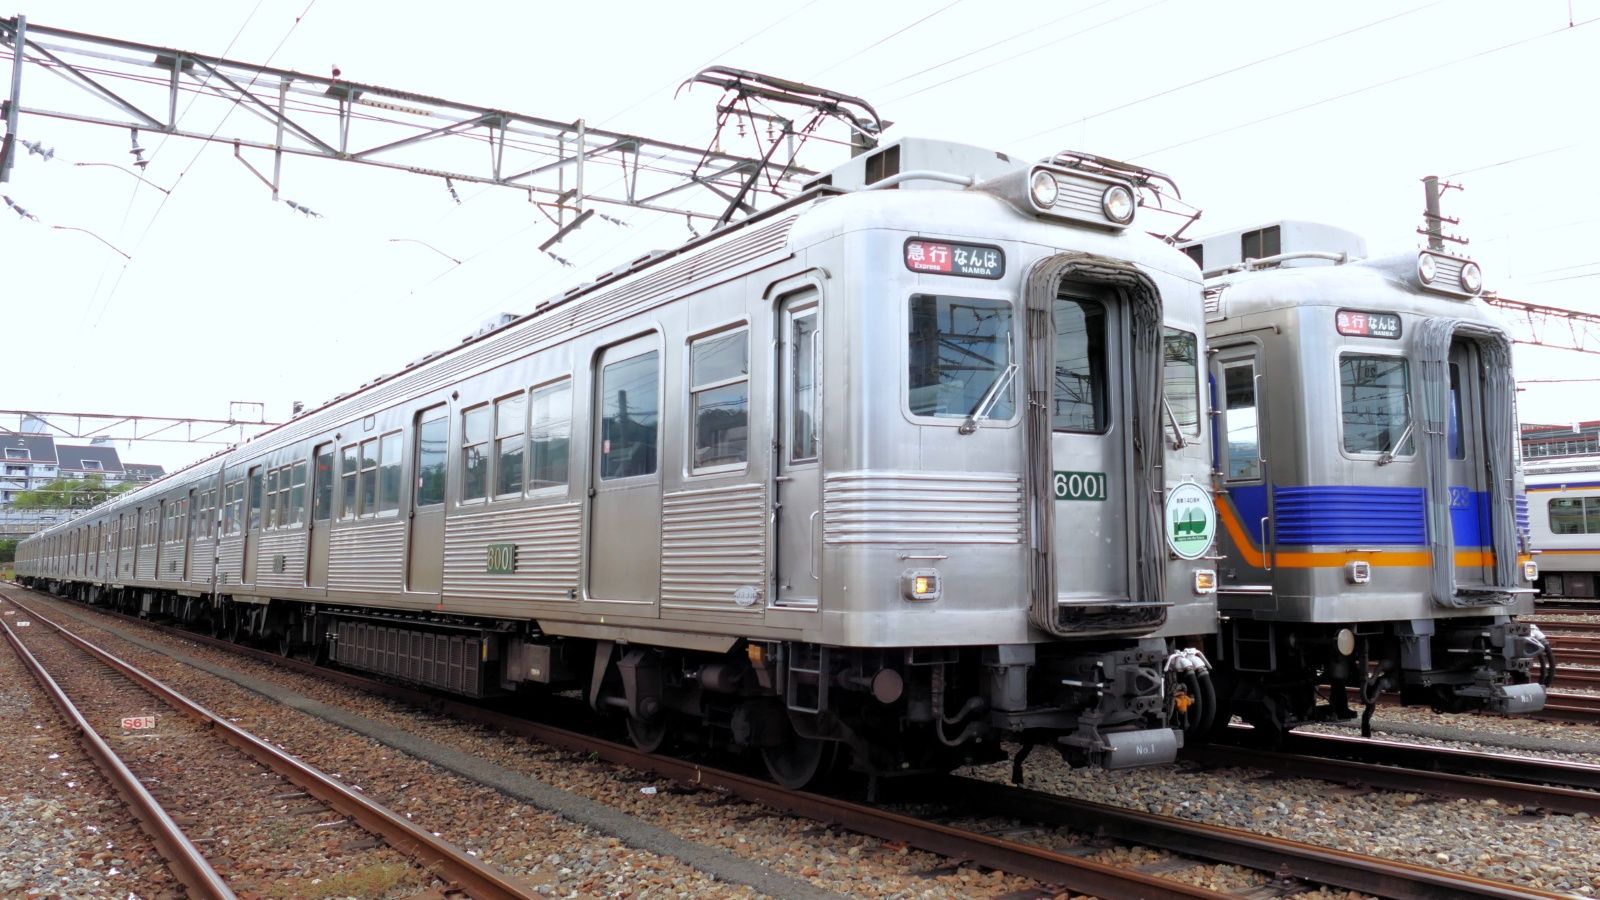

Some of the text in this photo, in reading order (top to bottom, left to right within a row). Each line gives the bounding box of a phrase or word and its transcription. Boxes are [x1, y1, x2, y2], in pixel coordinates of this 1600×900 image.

[908, 244, 948, 264] 急行
[914, 262, 992, 276] Express NAMBA
[1053, 473, 1106, 498] 6001
[487, 546, 513, 570] 6001
